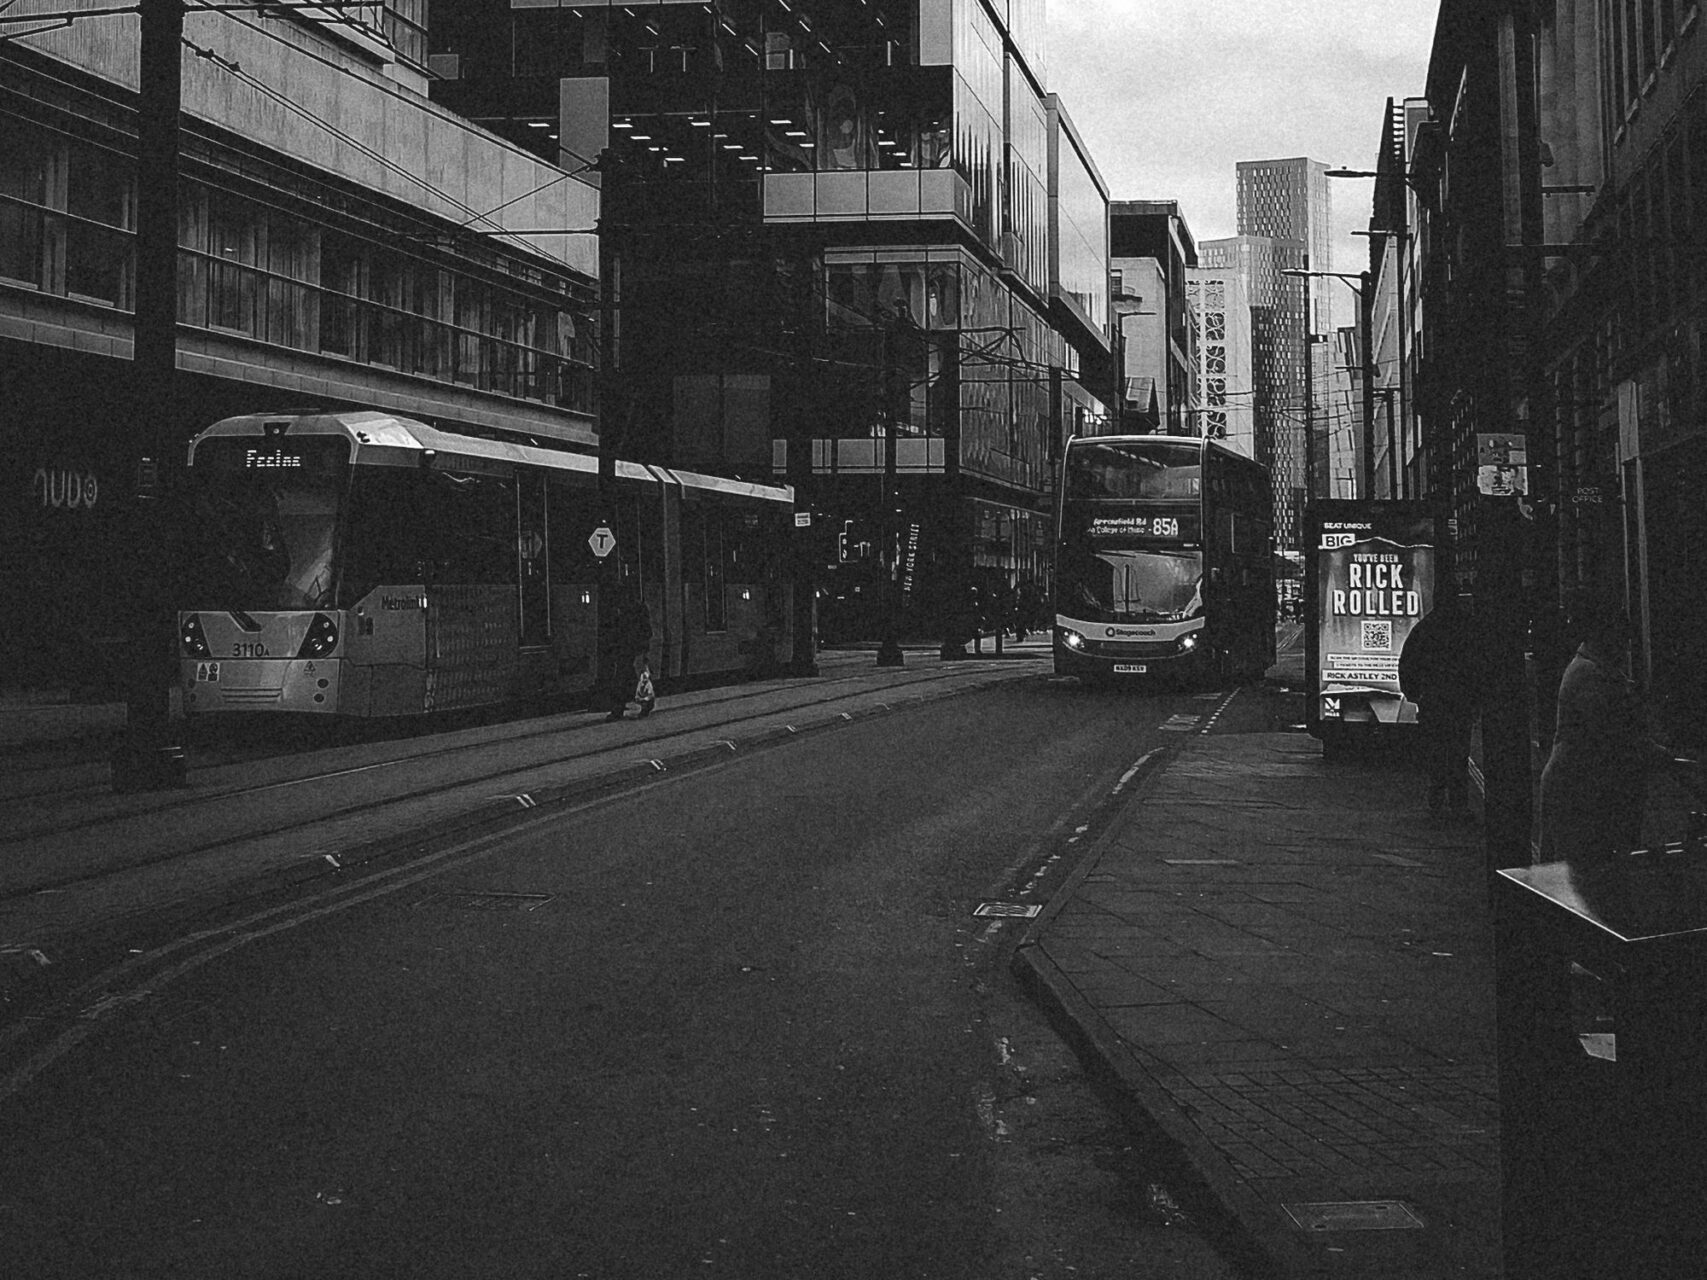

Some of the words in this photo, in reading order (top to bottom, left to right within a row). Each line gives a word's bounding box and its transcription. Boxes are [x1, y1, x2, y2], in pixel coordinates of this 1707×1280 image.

[1577, 487, 1599, 495] POST
[1571, 495, 1603, 504] OFFICE
[1152, 517, 1179, 536] 85A
[596, 533, 609, 549] T
[1325, 535, 1353, 547] BIG
[905, 552, 916, 573] YORK
[1353, 553, 1378, 563] YOU'VE
[1380, 553, 1399, 563] BEEN
[1349, 563, 1404, 589] RICK
[1333, 589, 1419, 616] ROLLED
[1116, 628, 1157, 637] Stagecoach
[1327, 672, 1346, 680] RICK
[1347, 672, 1379, 680] ASTLEY
